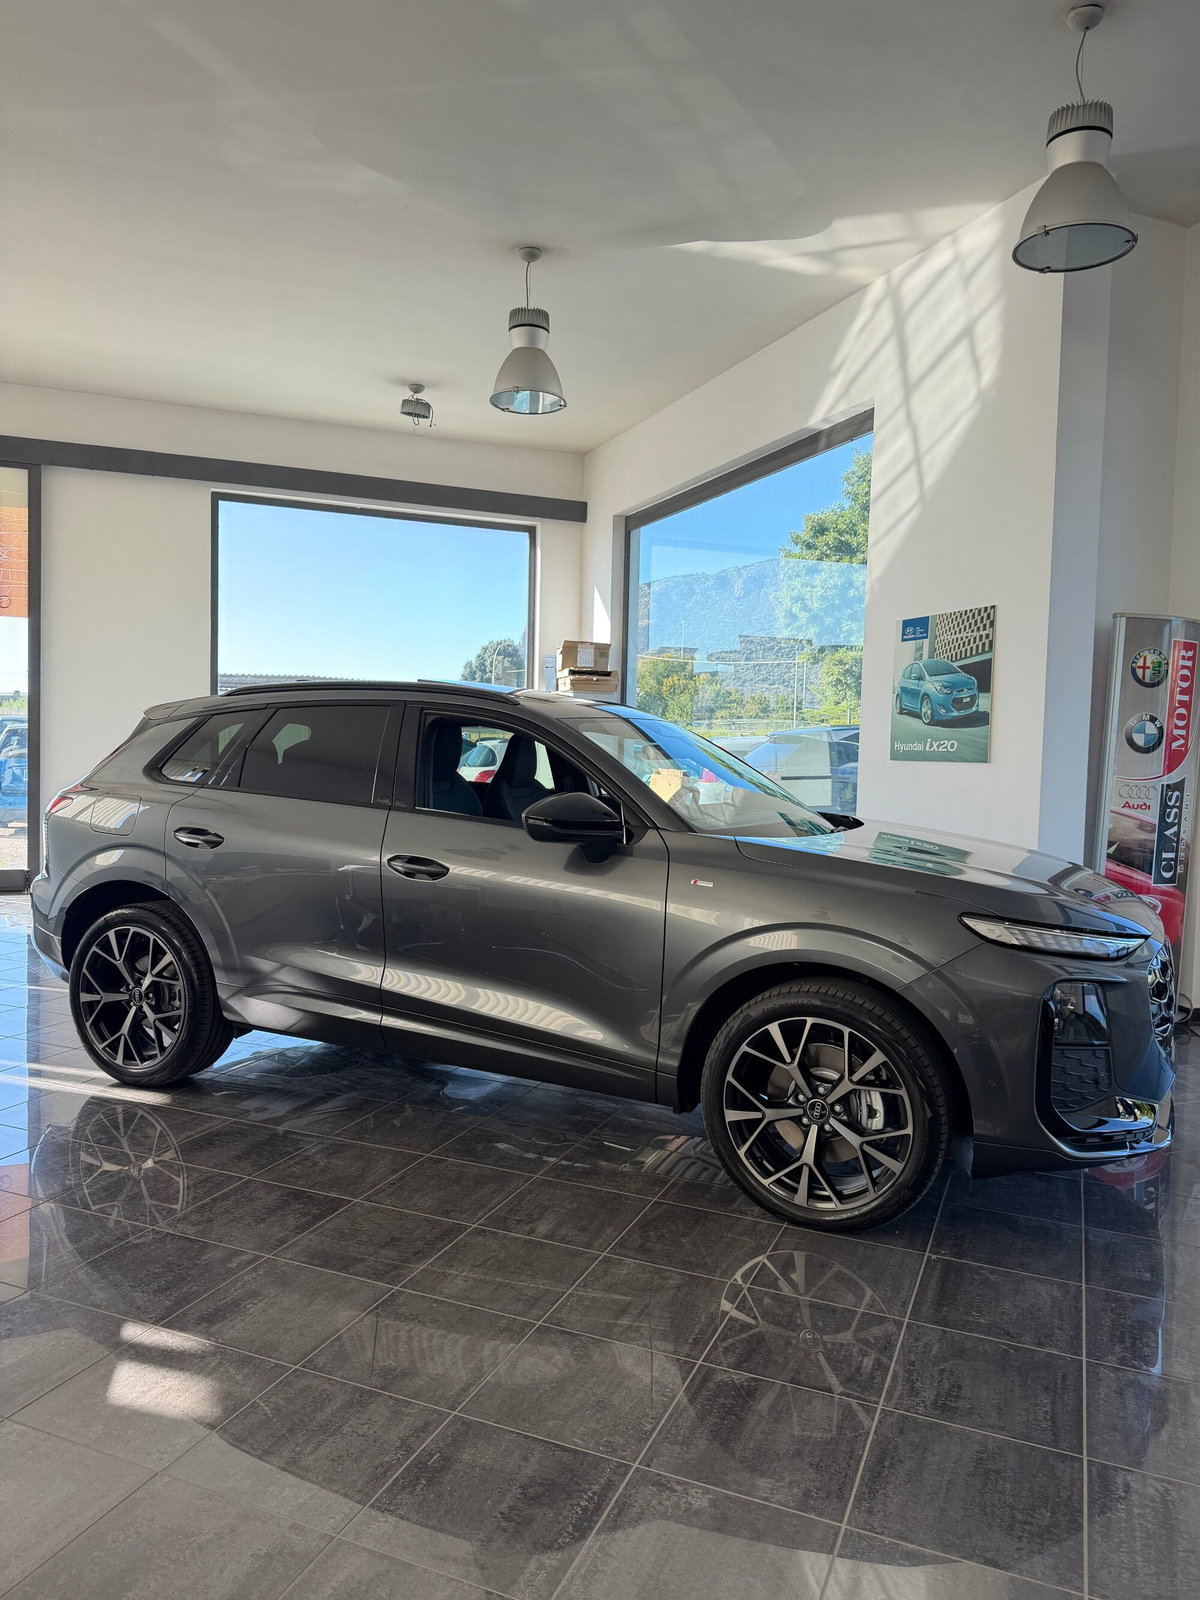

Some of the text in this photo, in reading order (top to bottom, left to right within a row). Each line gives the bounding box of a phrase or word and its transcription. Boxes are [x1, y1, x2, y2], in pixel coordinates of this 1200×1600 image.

[1171, 649, 1194, 752] MOTOR
[1129, 714, 1162, 728] BMW
[894, 740, 924, 753] Hyundai
[1121, 800, 1151, 811] Audi
[1160, 790, 1181, 879] CLASS
